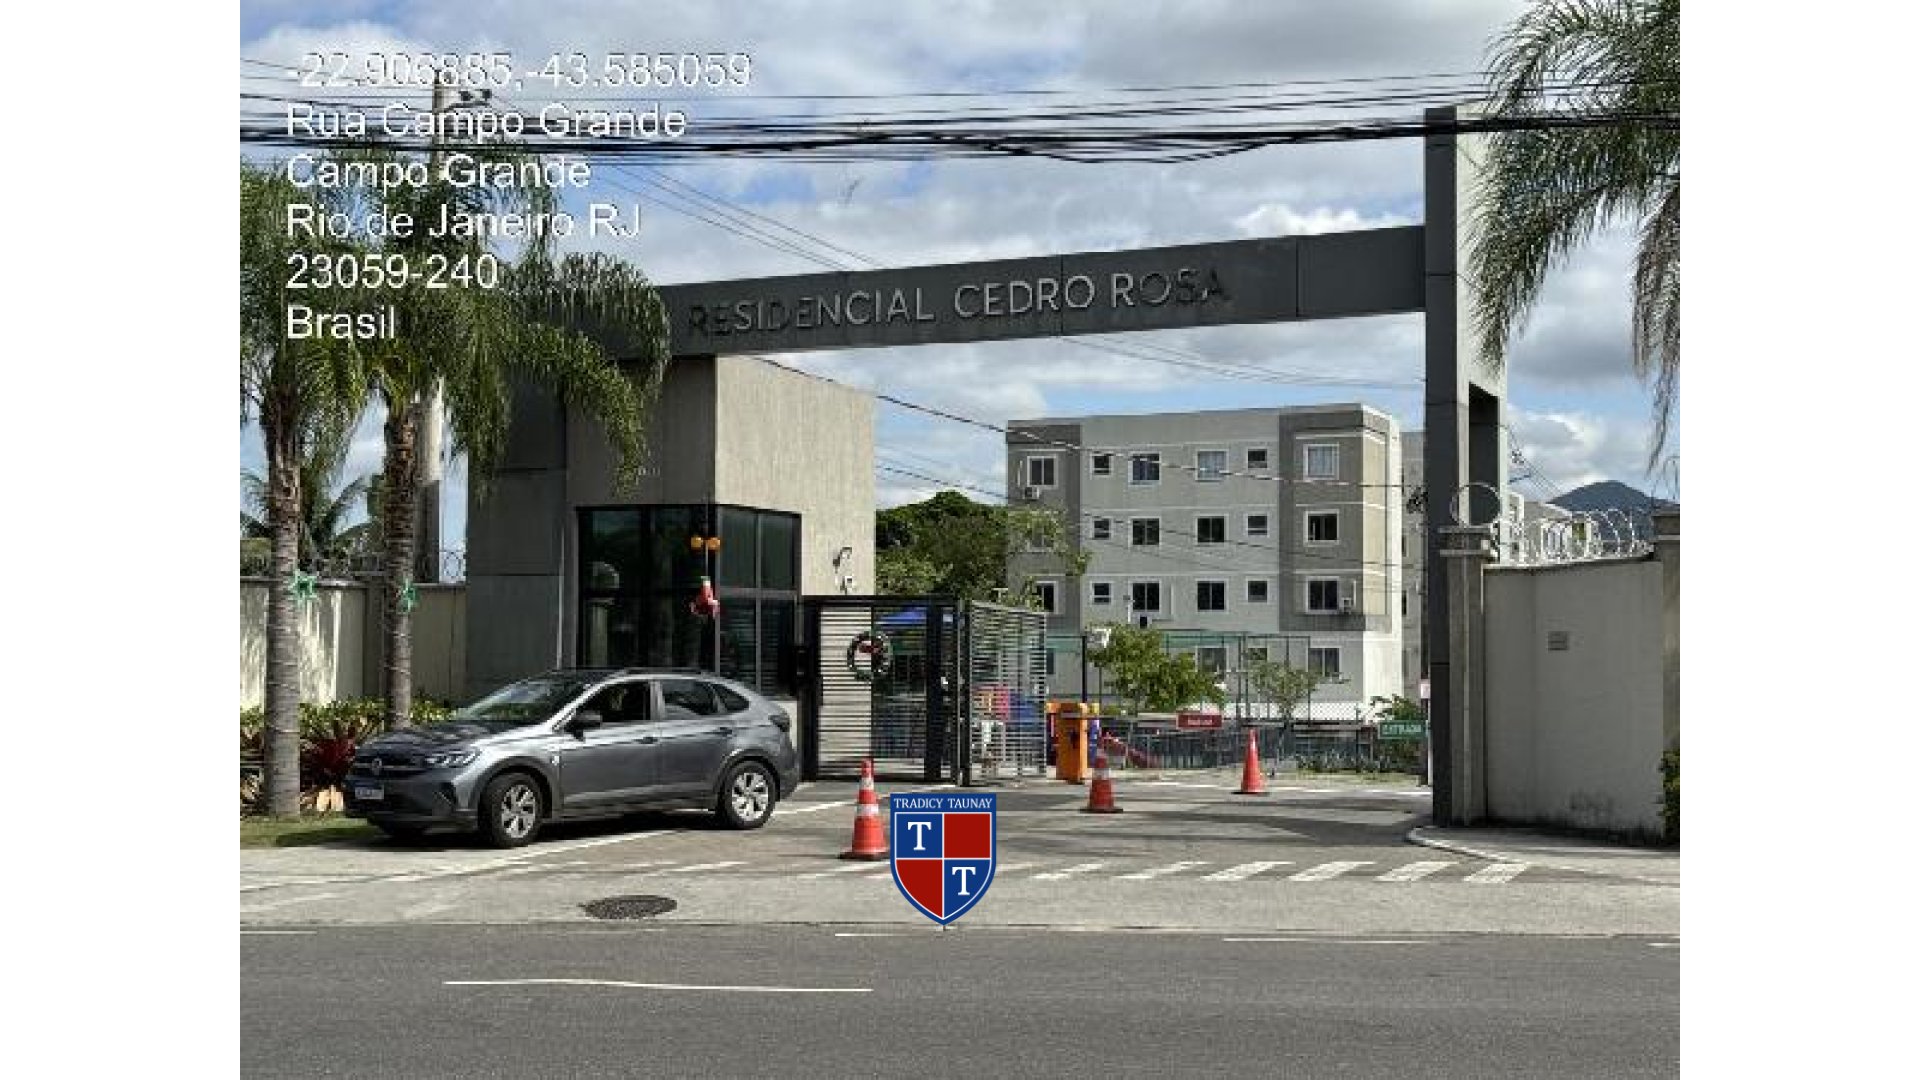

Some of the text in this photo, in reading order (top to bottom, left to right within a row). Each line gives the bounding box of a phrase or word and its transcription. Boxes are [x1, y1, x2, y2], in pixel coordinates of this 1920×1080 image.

[688, 268, 1226, 337] RESIDENCIAL CEDRO ROSA
